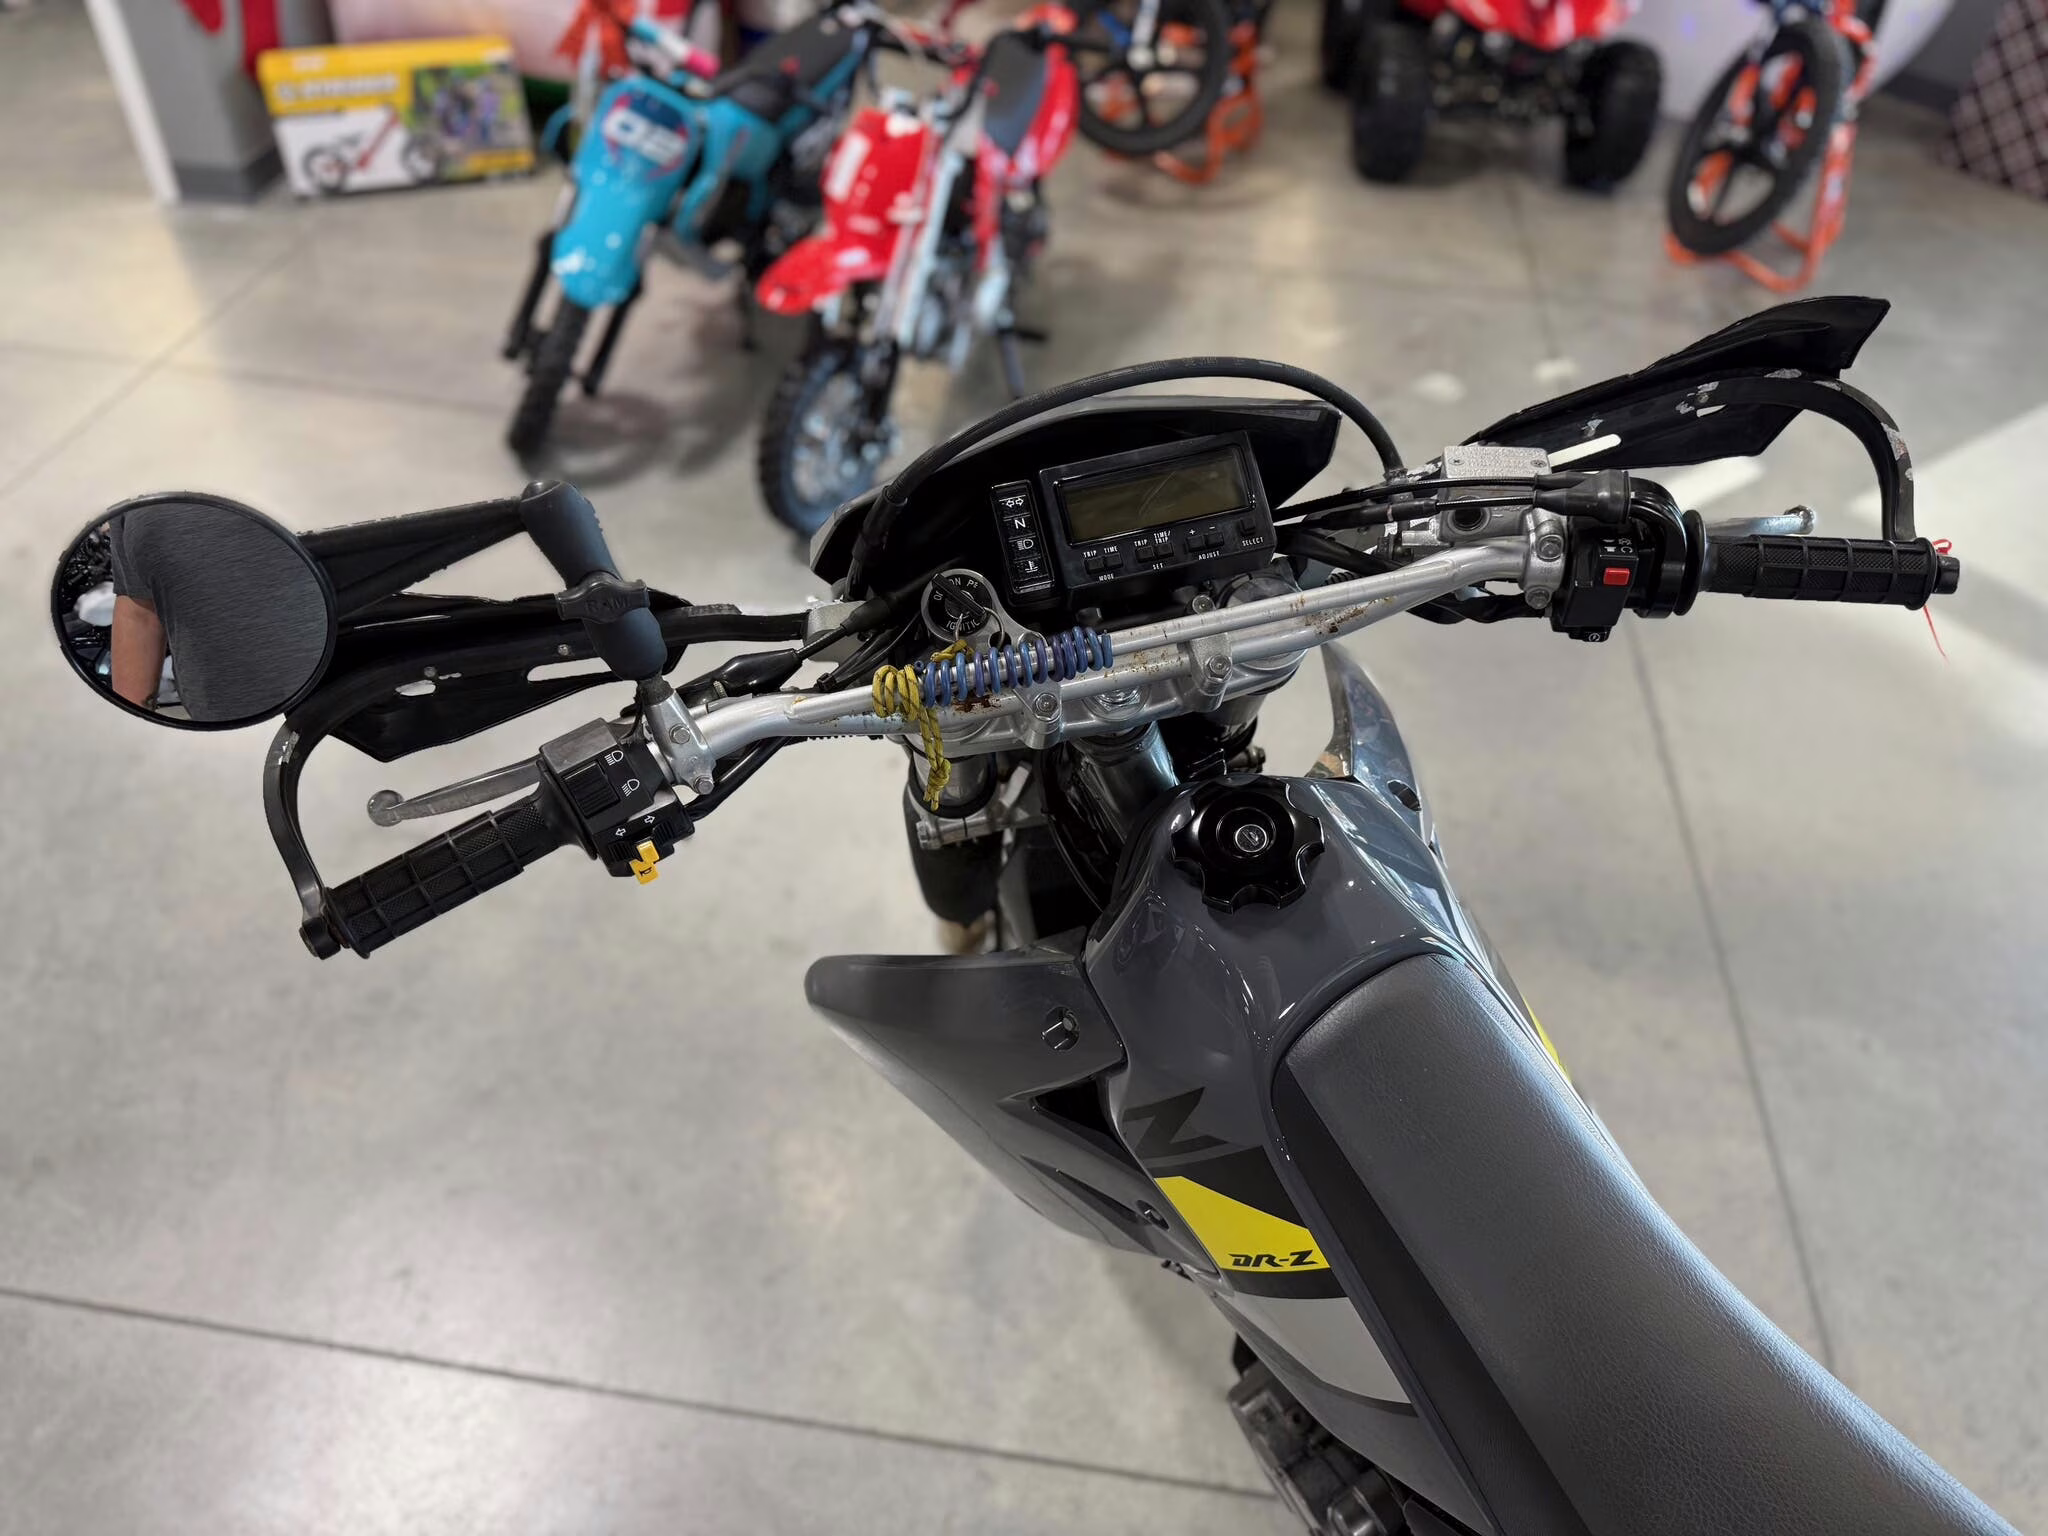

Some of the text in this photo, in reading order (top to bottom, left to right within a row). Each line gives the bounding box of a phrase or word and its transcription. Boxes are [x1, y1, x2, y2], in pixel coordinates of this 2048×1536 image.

[1014, 518, 1026, 529] N
[1133, 539, 1148, 547] TRIP
[1242, 537, 1264, 547] SELECT
[1083, 545, 1118, 558] TRIP TIME
[1198, 550, 1220, 561] ADJUST
[1152, 562, 1164, 570] SET
[1098, 573, 1115, 582] MODE
[1228, 1249, 1319, 1268] DR-Z
